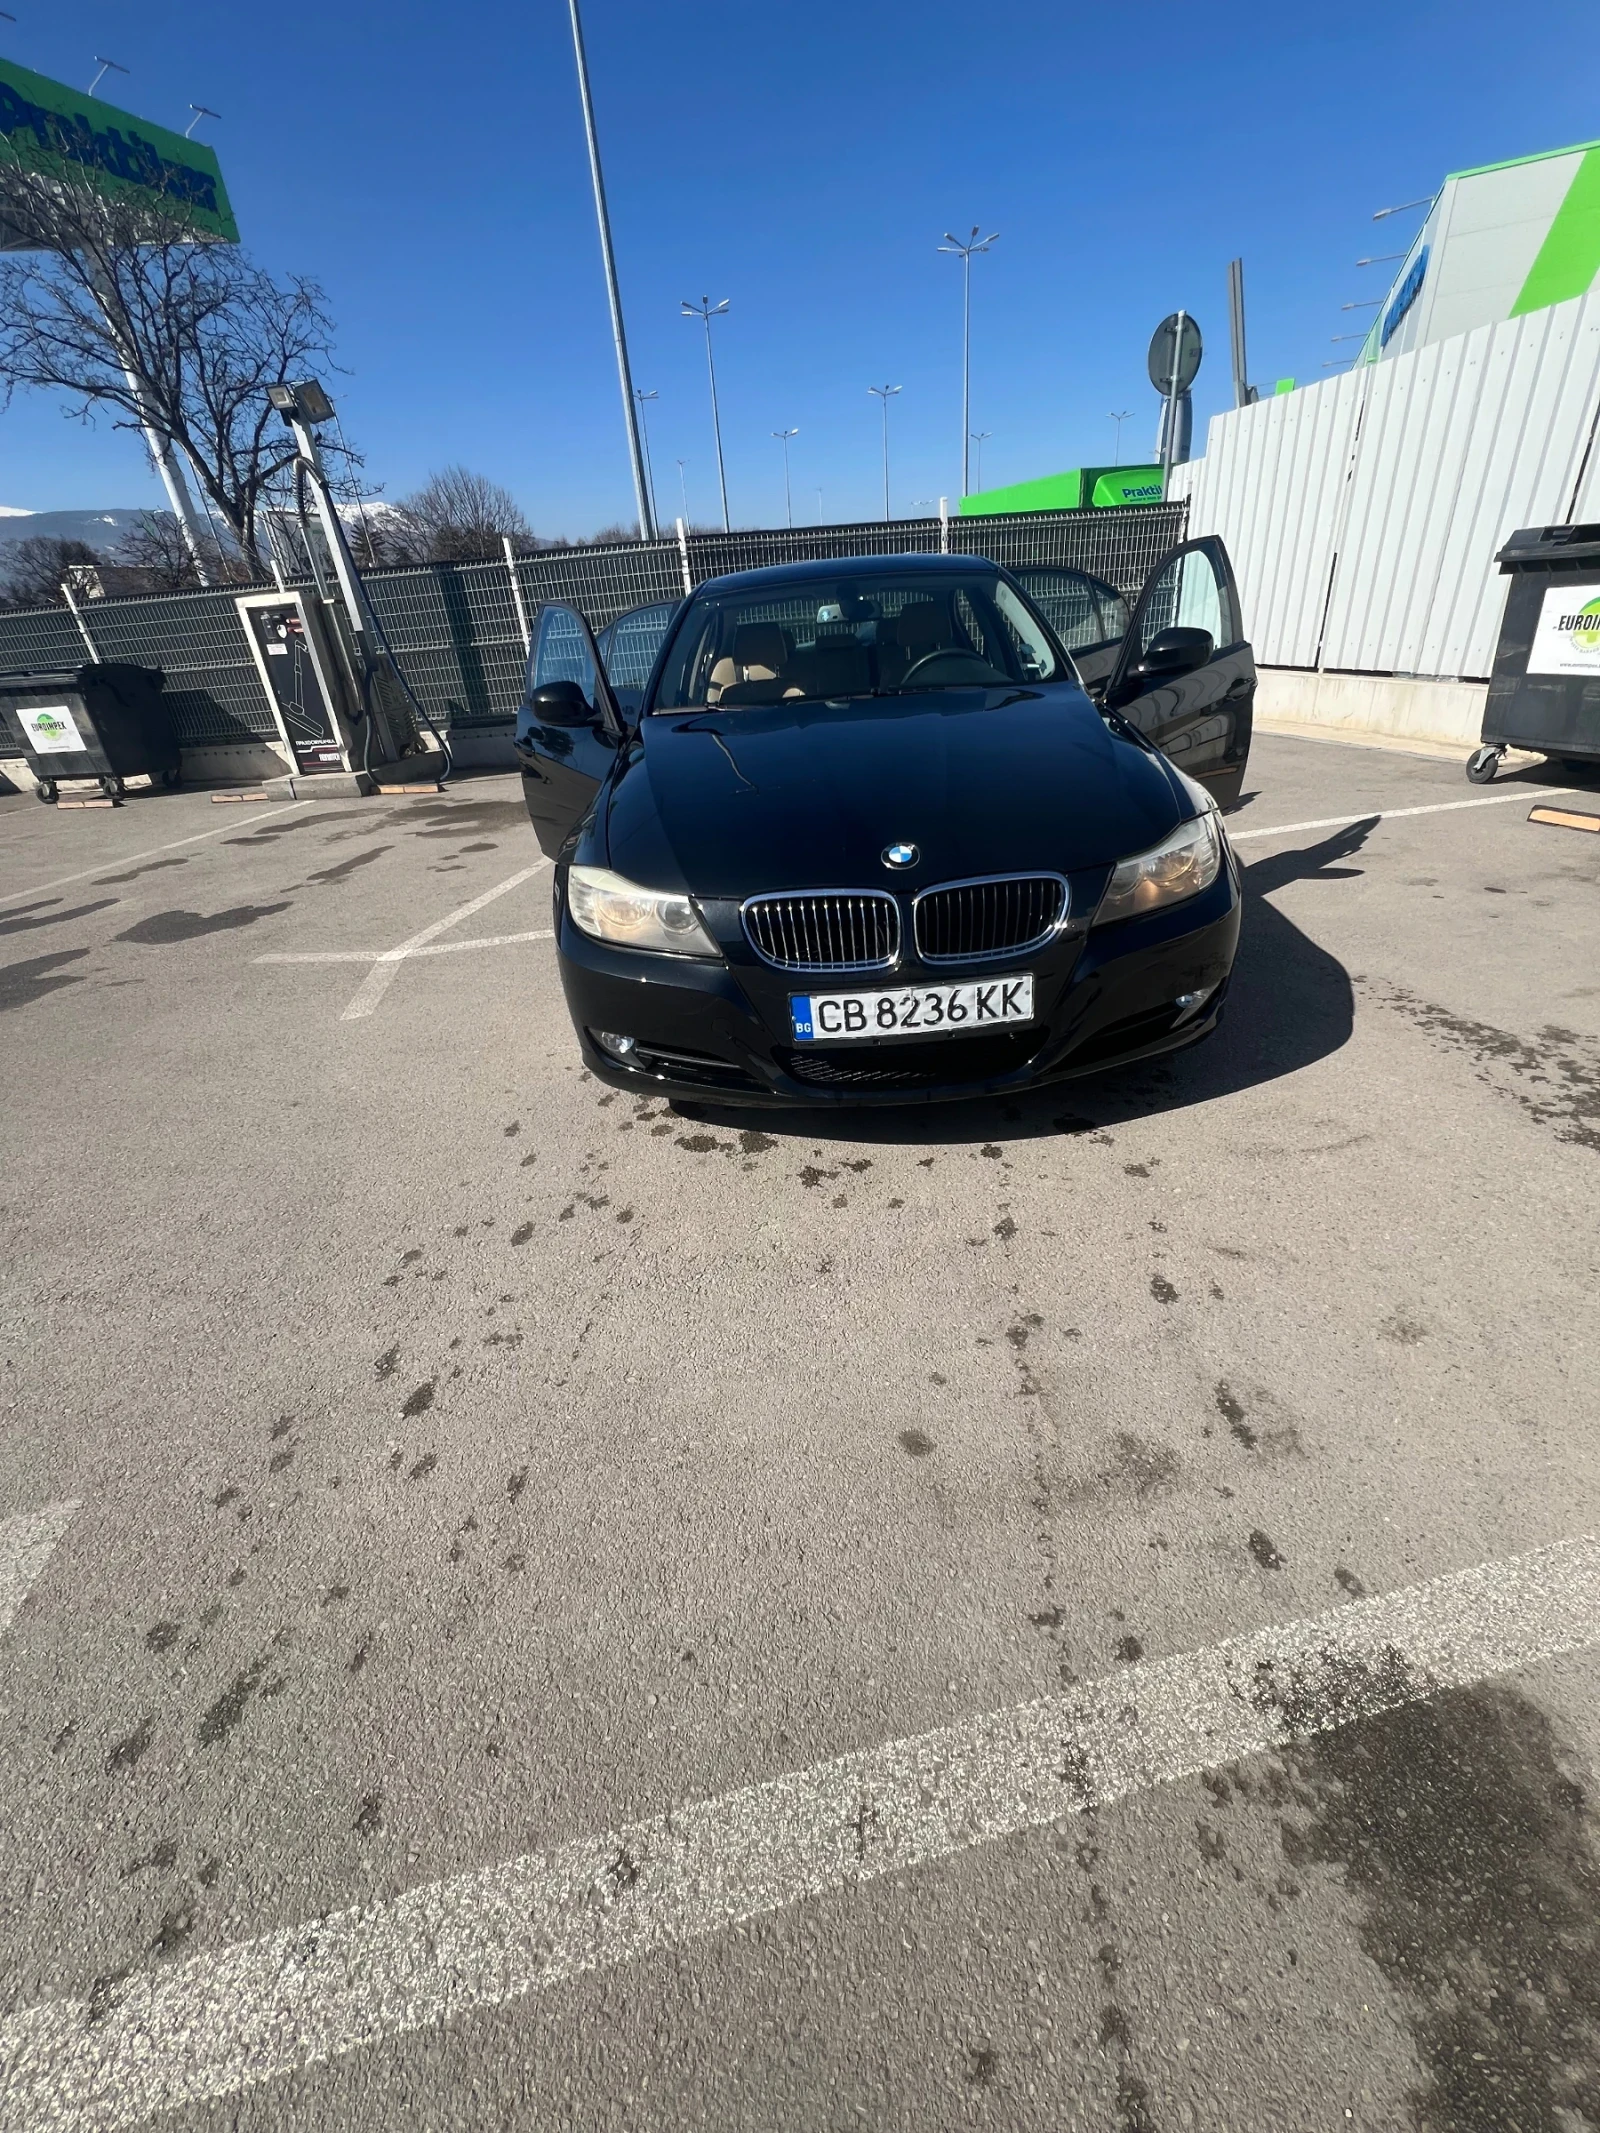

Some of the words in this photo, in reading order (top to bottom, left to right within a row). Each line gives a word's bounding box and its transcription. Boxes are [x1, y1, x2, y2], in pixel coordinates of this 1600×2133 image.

[31, 721, 67, 732] EUROIMPEX
[818, 999, 867, 1032] CB
[876, 989, 968, 1029] 8236
[975, 981, 1024, 1020] KK
[796, 1023, 811, 1033] BG
